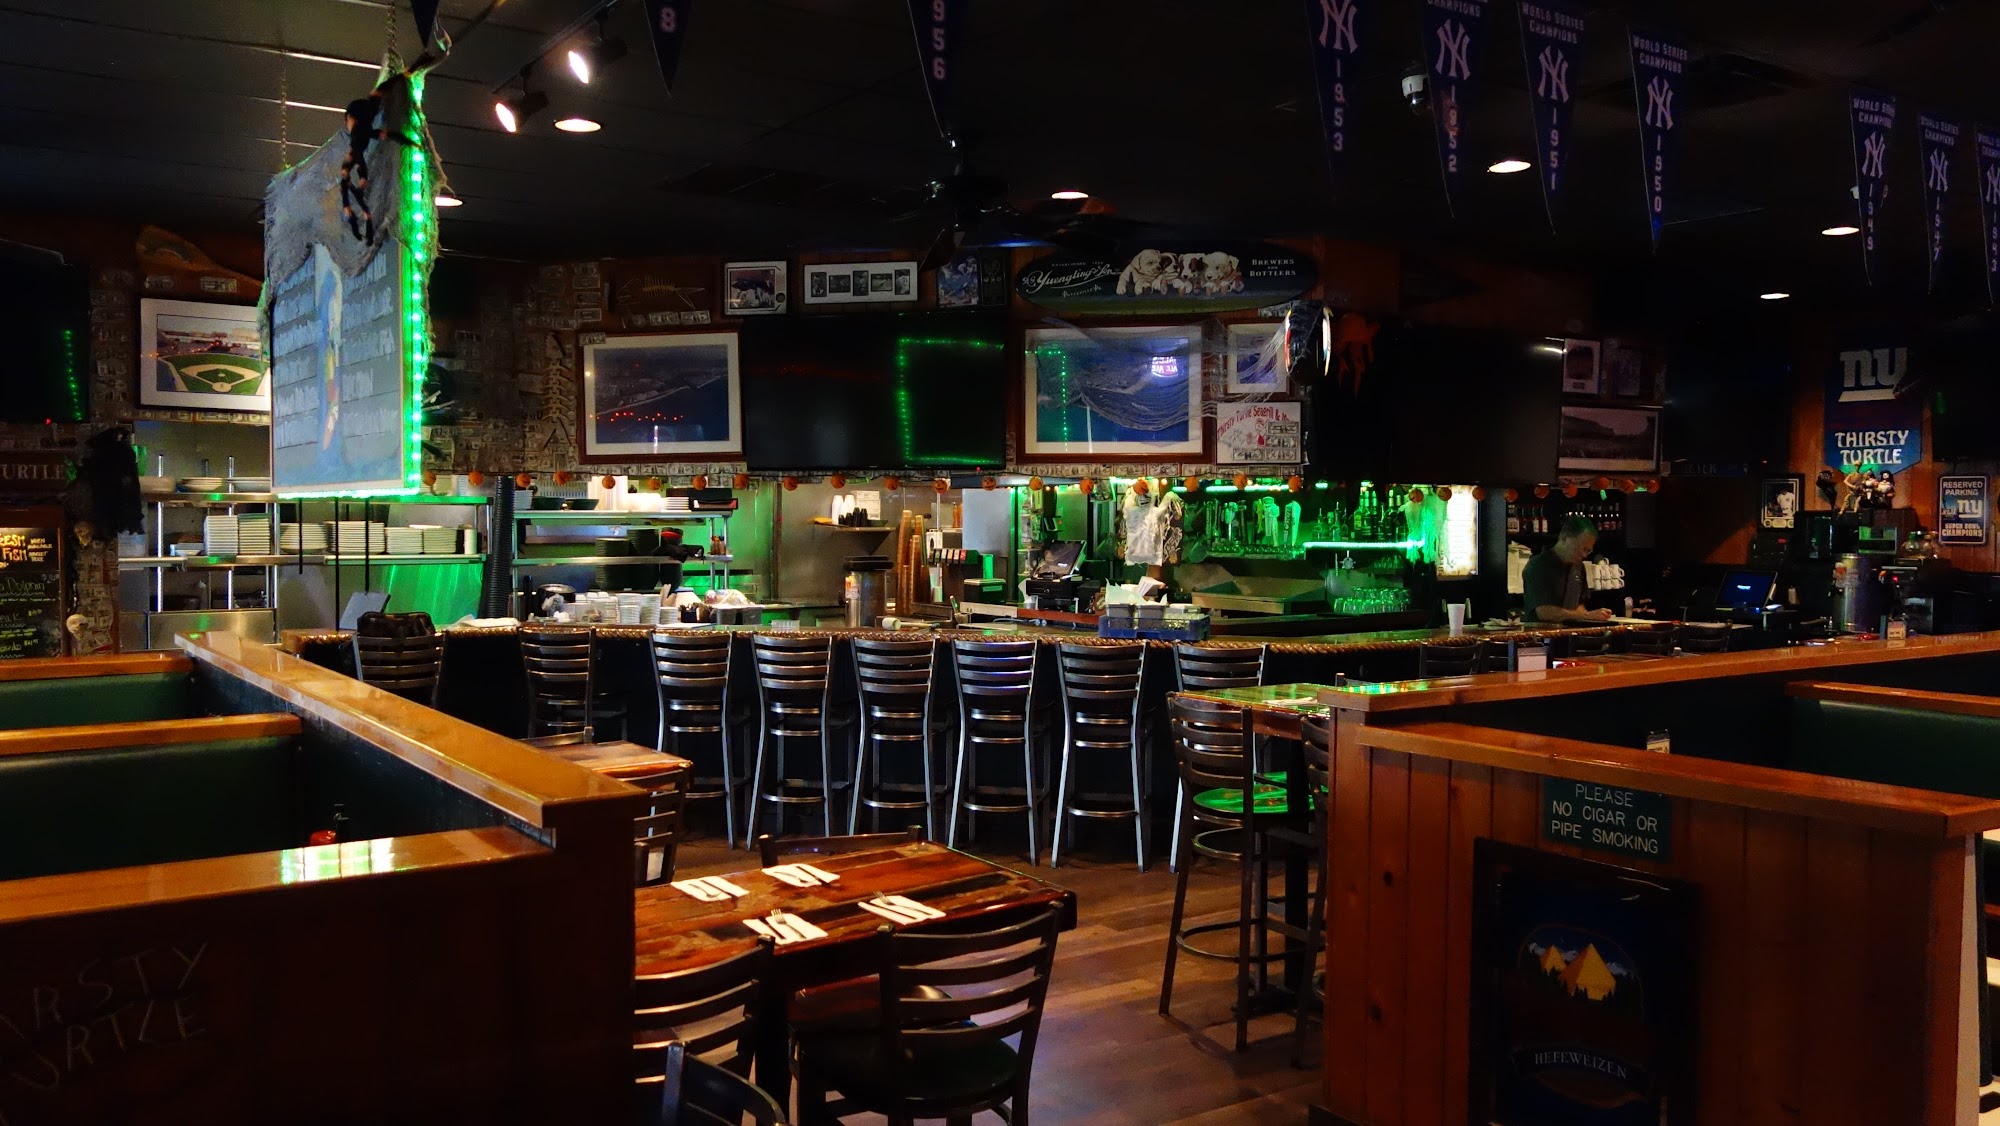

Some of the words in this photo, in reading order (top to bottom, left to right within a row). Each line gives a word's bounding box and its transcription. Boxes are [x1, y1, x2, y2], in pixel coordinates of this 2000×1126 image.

[658, 7, 678, 33] 8
[1435, 18, 1471, 81] NY
[1632, 35, 1661, 54] WORLD
[1538, 45, 1570, 103] NY
[1639, 53, 1682, 74] CHAMPIONS
[1333, 58, 1345, 152] 1953
[1645, 75, 1675, 130] NY
[1448, 86, 1459, 173] 1952
[1549, 107, 1560, 191] 1951
[1861, 131, 1886, 179] NY
[1653, 134, 1664, 212] 1950
[1251, 258, 1295, 266] BREWERS
[1025, 268, 1092, 294] Yuengling
[1835, 430, 1909, 448] THIRSTY
[1840, 448, 1902, 466] TURTLE
[1942, 529, 1983, 537] CHAMPIONS
[1575, 783, 1634, 807] PLEASE
[1552, 800, 1573, 817] NO
[1582, 805, 1626, 827] CIGAR
[1636, 815, 1658, 833] OR
[1551, 820, 1582, 840] PIPE
[1592, 828, 1659, 854] SMOKING
[1534, 1051, 1628, 1080] HEFEWEIZEN
